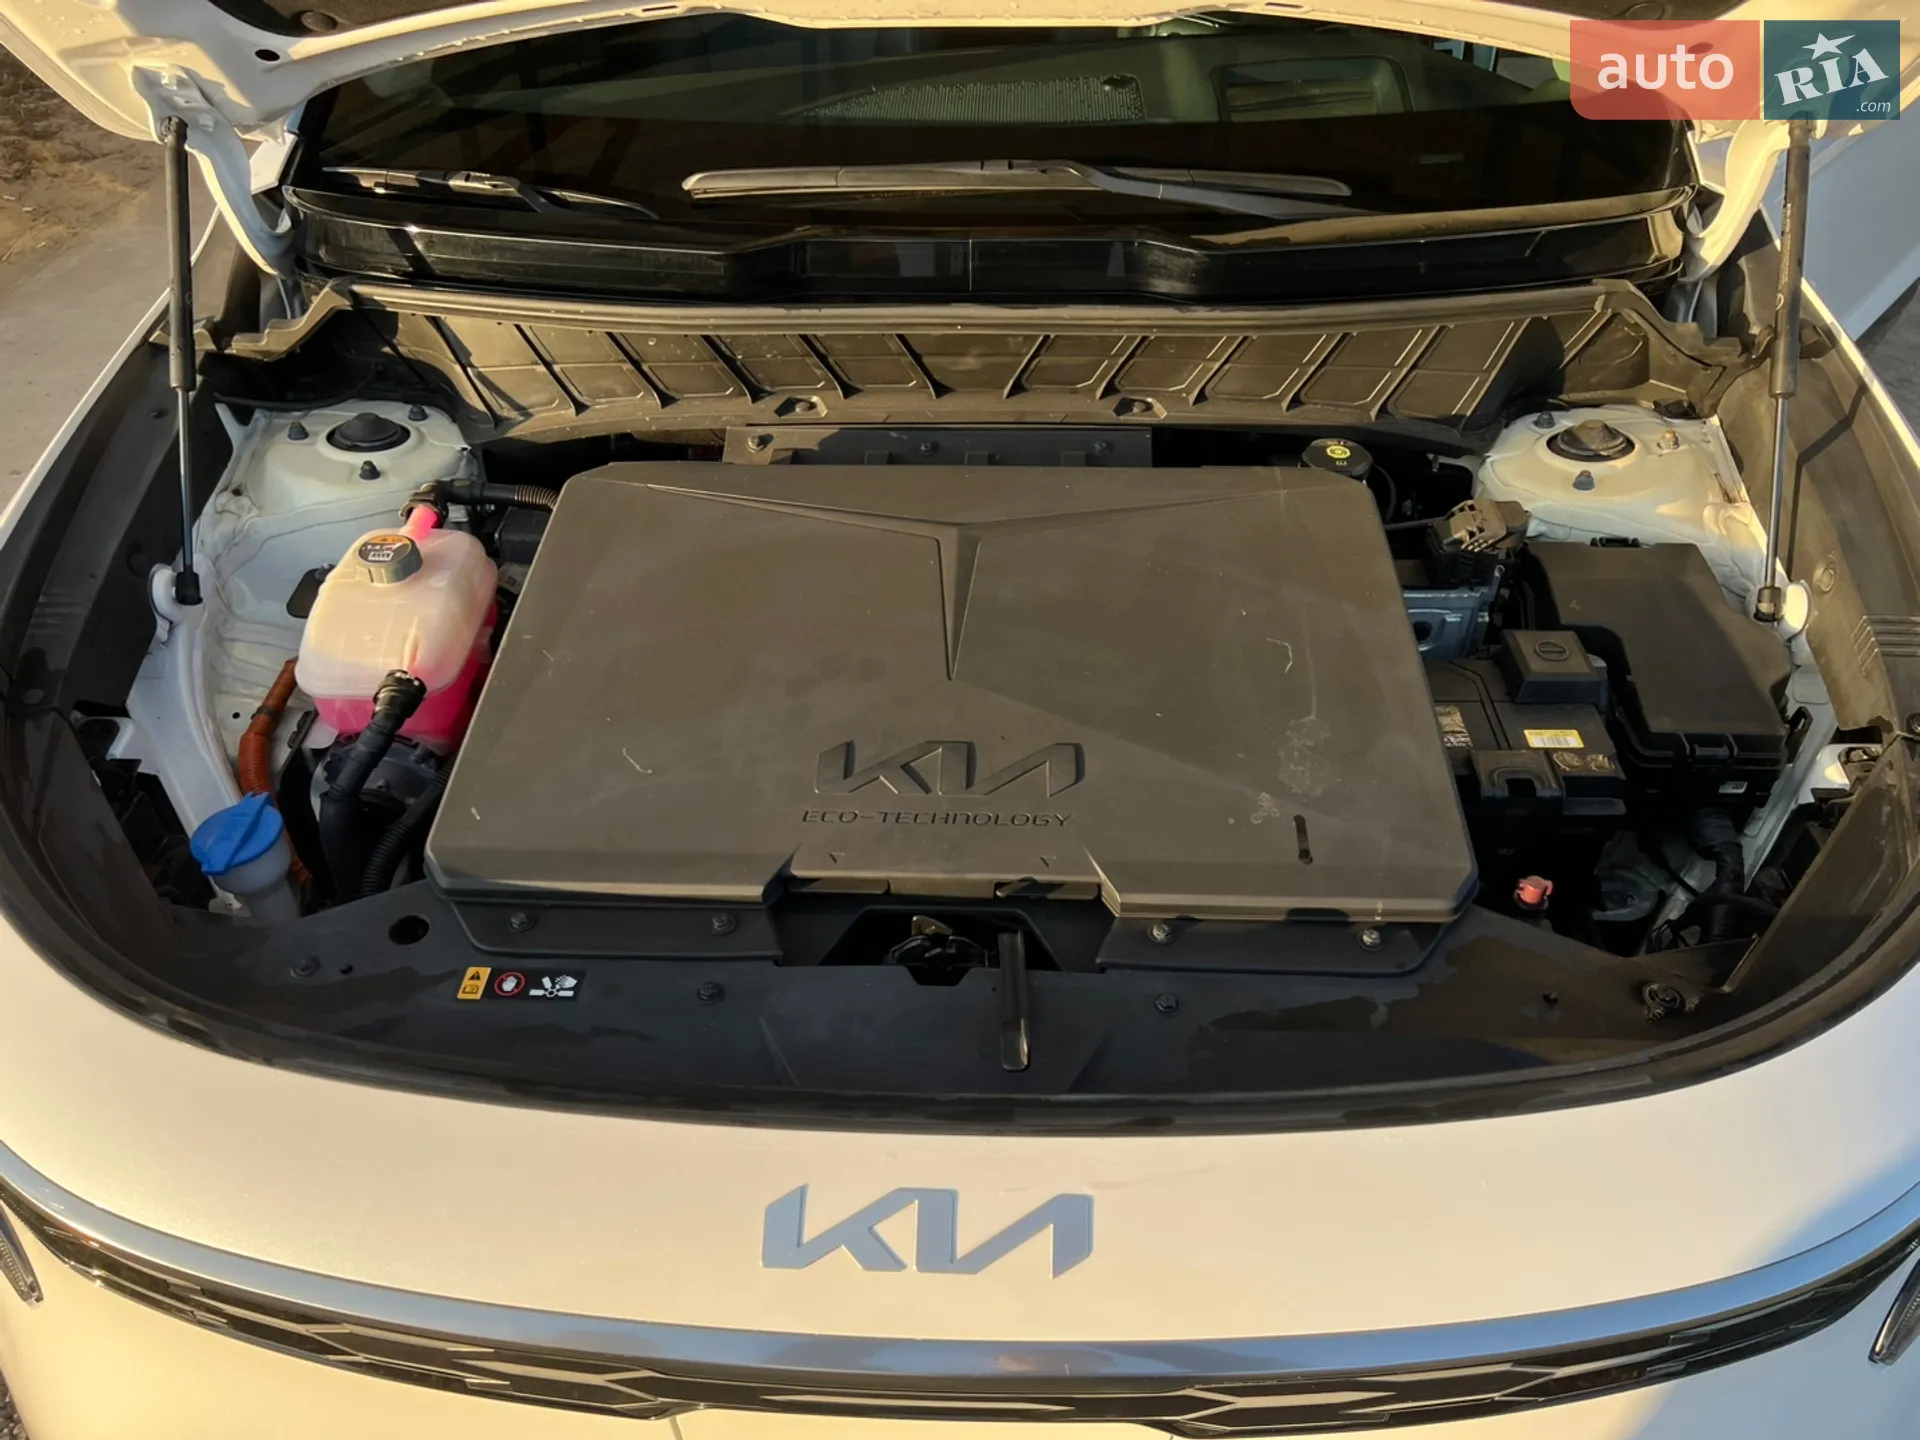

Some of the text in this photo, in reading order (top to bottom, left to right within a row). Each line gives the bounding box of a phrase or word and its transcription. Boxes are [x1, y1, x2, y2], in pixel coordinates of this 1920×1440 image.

[814, 740, 1085, 798] KIA
[802, 810, 1072, 827] ECO-TECHNOLOGY
[761, 1183, 1095, 1279] KIA
